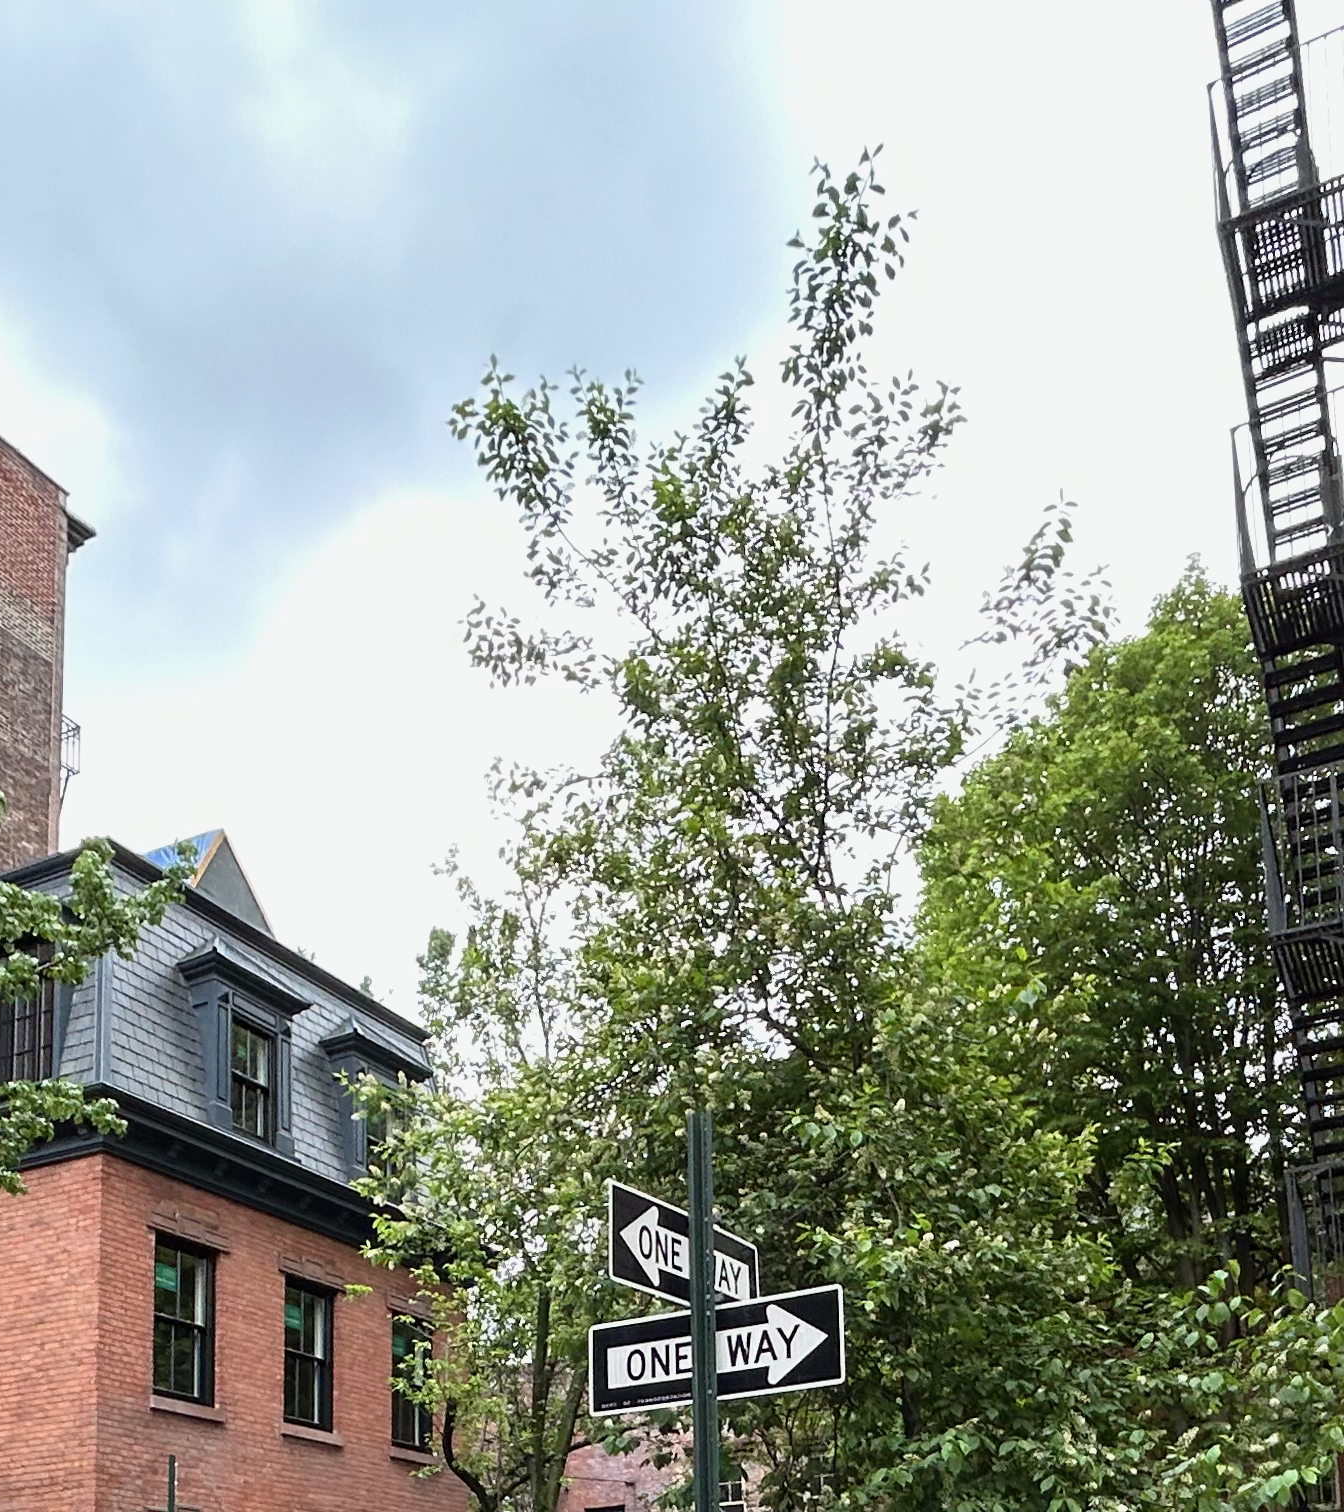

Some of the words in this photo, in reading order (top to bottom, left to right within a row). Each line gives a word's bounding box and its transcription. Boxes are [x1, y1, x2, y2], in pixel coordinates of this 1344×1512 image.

[639, 1225, 683, 1273] ONE
[713, 1255, 742, 1295] AY
[627, 1345, 691, 1381] ONE
[727, 1325, 800, 1368] WAY
